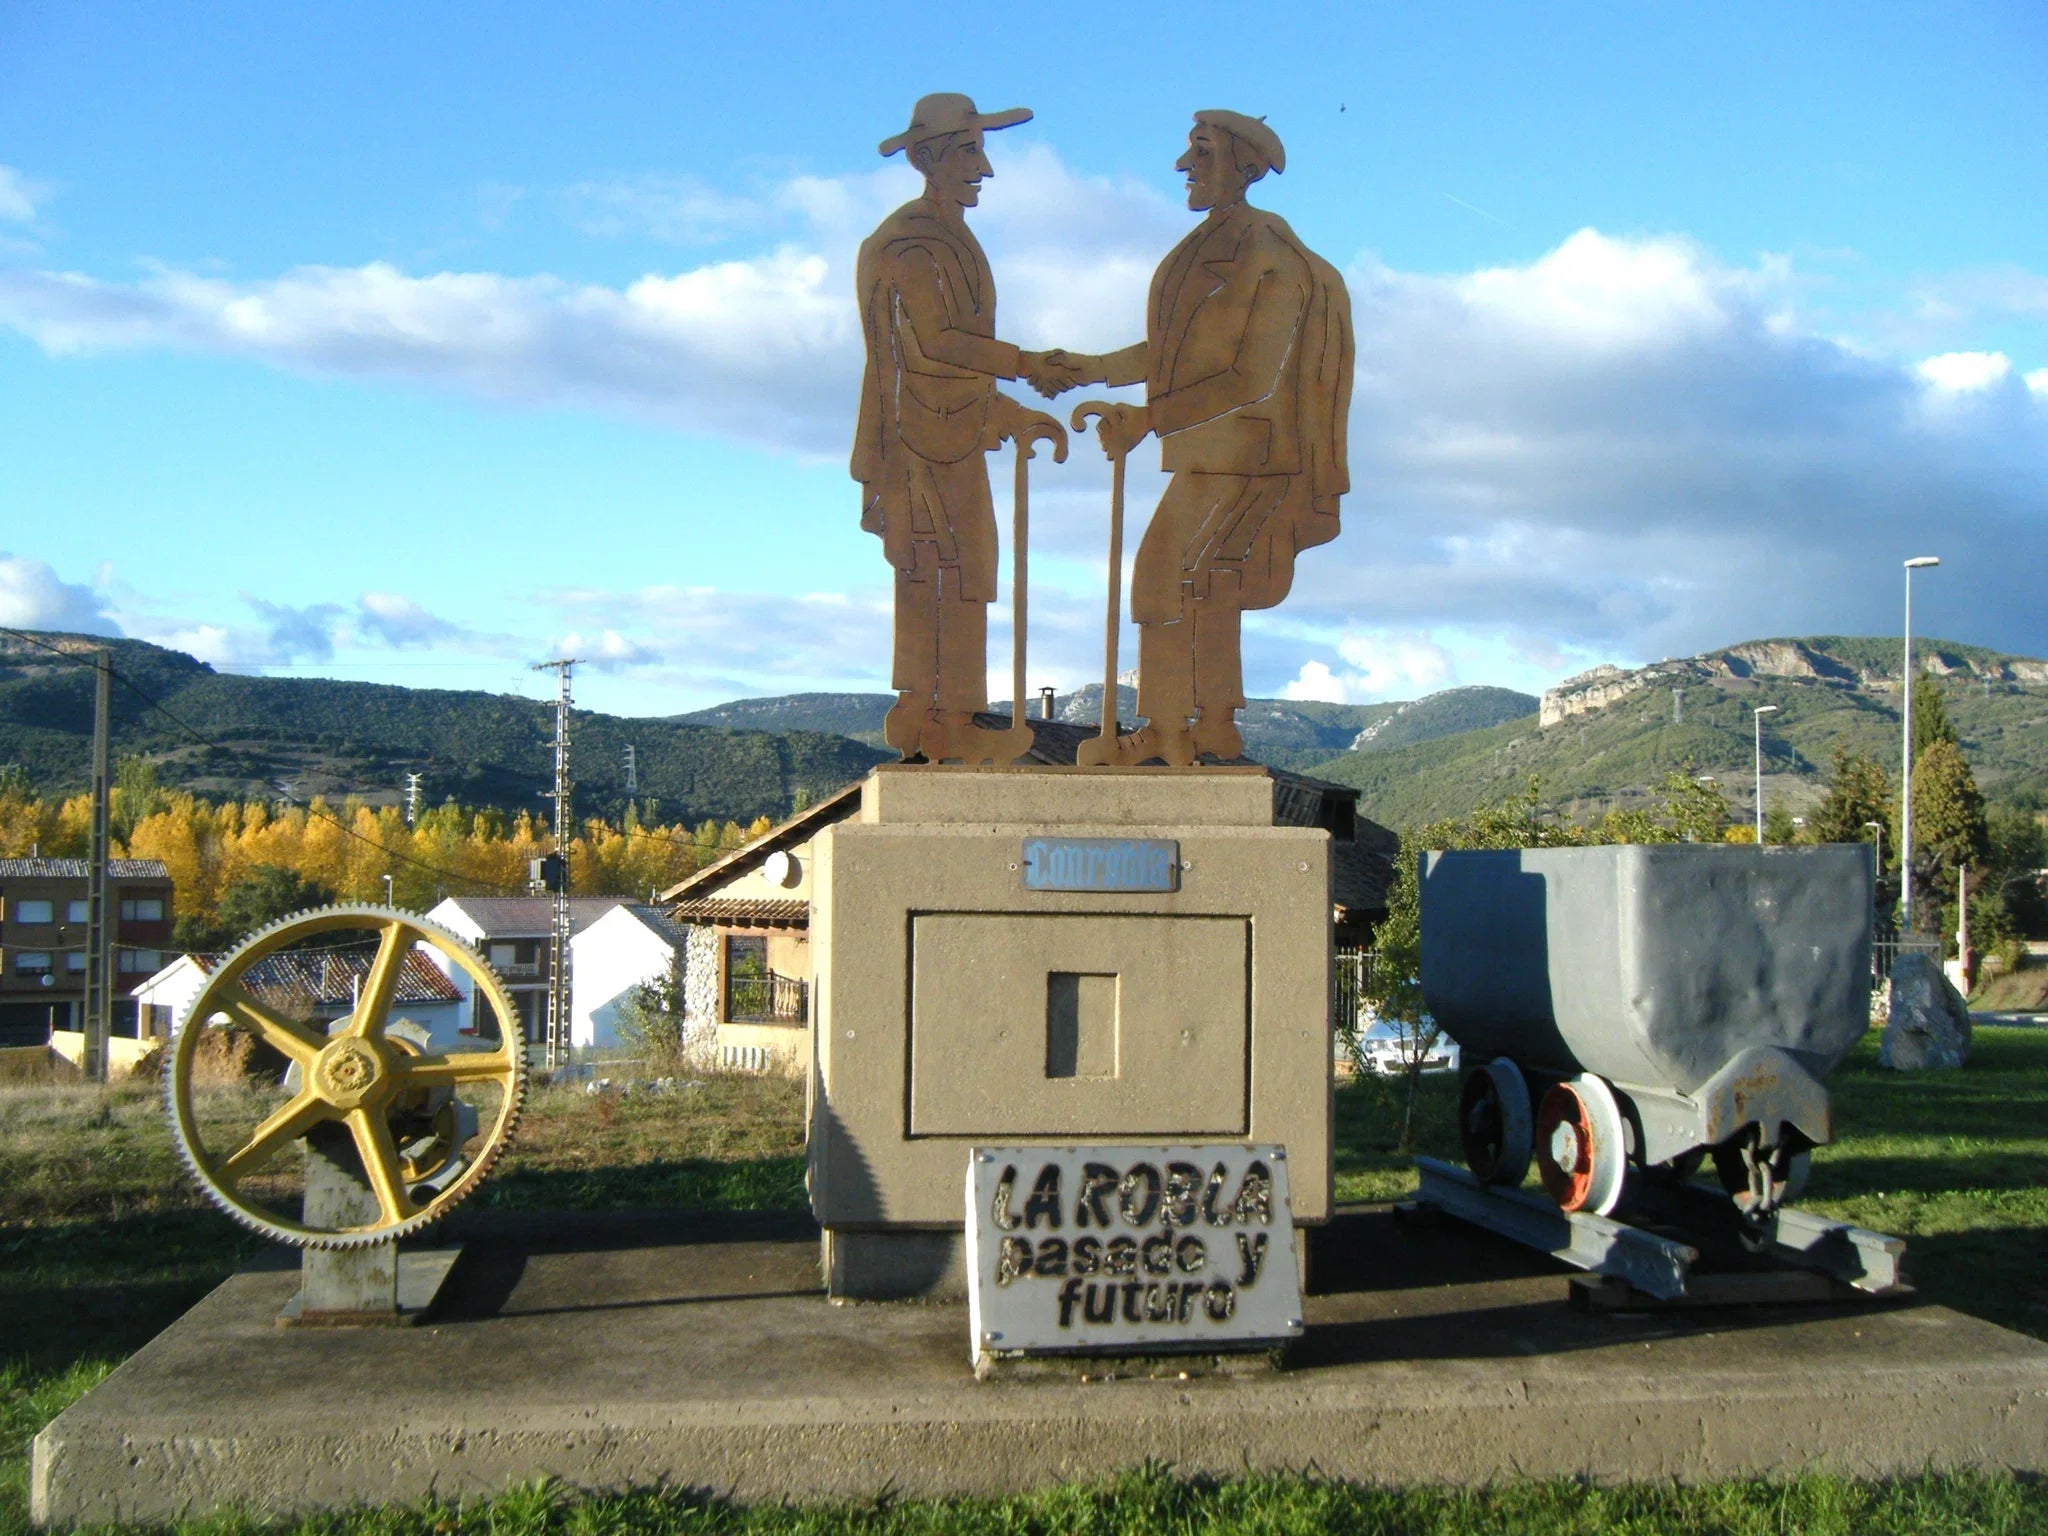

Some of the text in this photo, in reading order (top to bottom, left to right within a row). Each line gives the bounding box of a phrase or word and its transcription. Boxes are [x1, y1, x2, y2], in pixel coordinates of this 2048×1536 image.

[993, 1161, 1272, 1230] LA ROBLA
[996, 1227, 1268, 1287] pasado y
[1058, 1277, 1236, 1327] futuro
